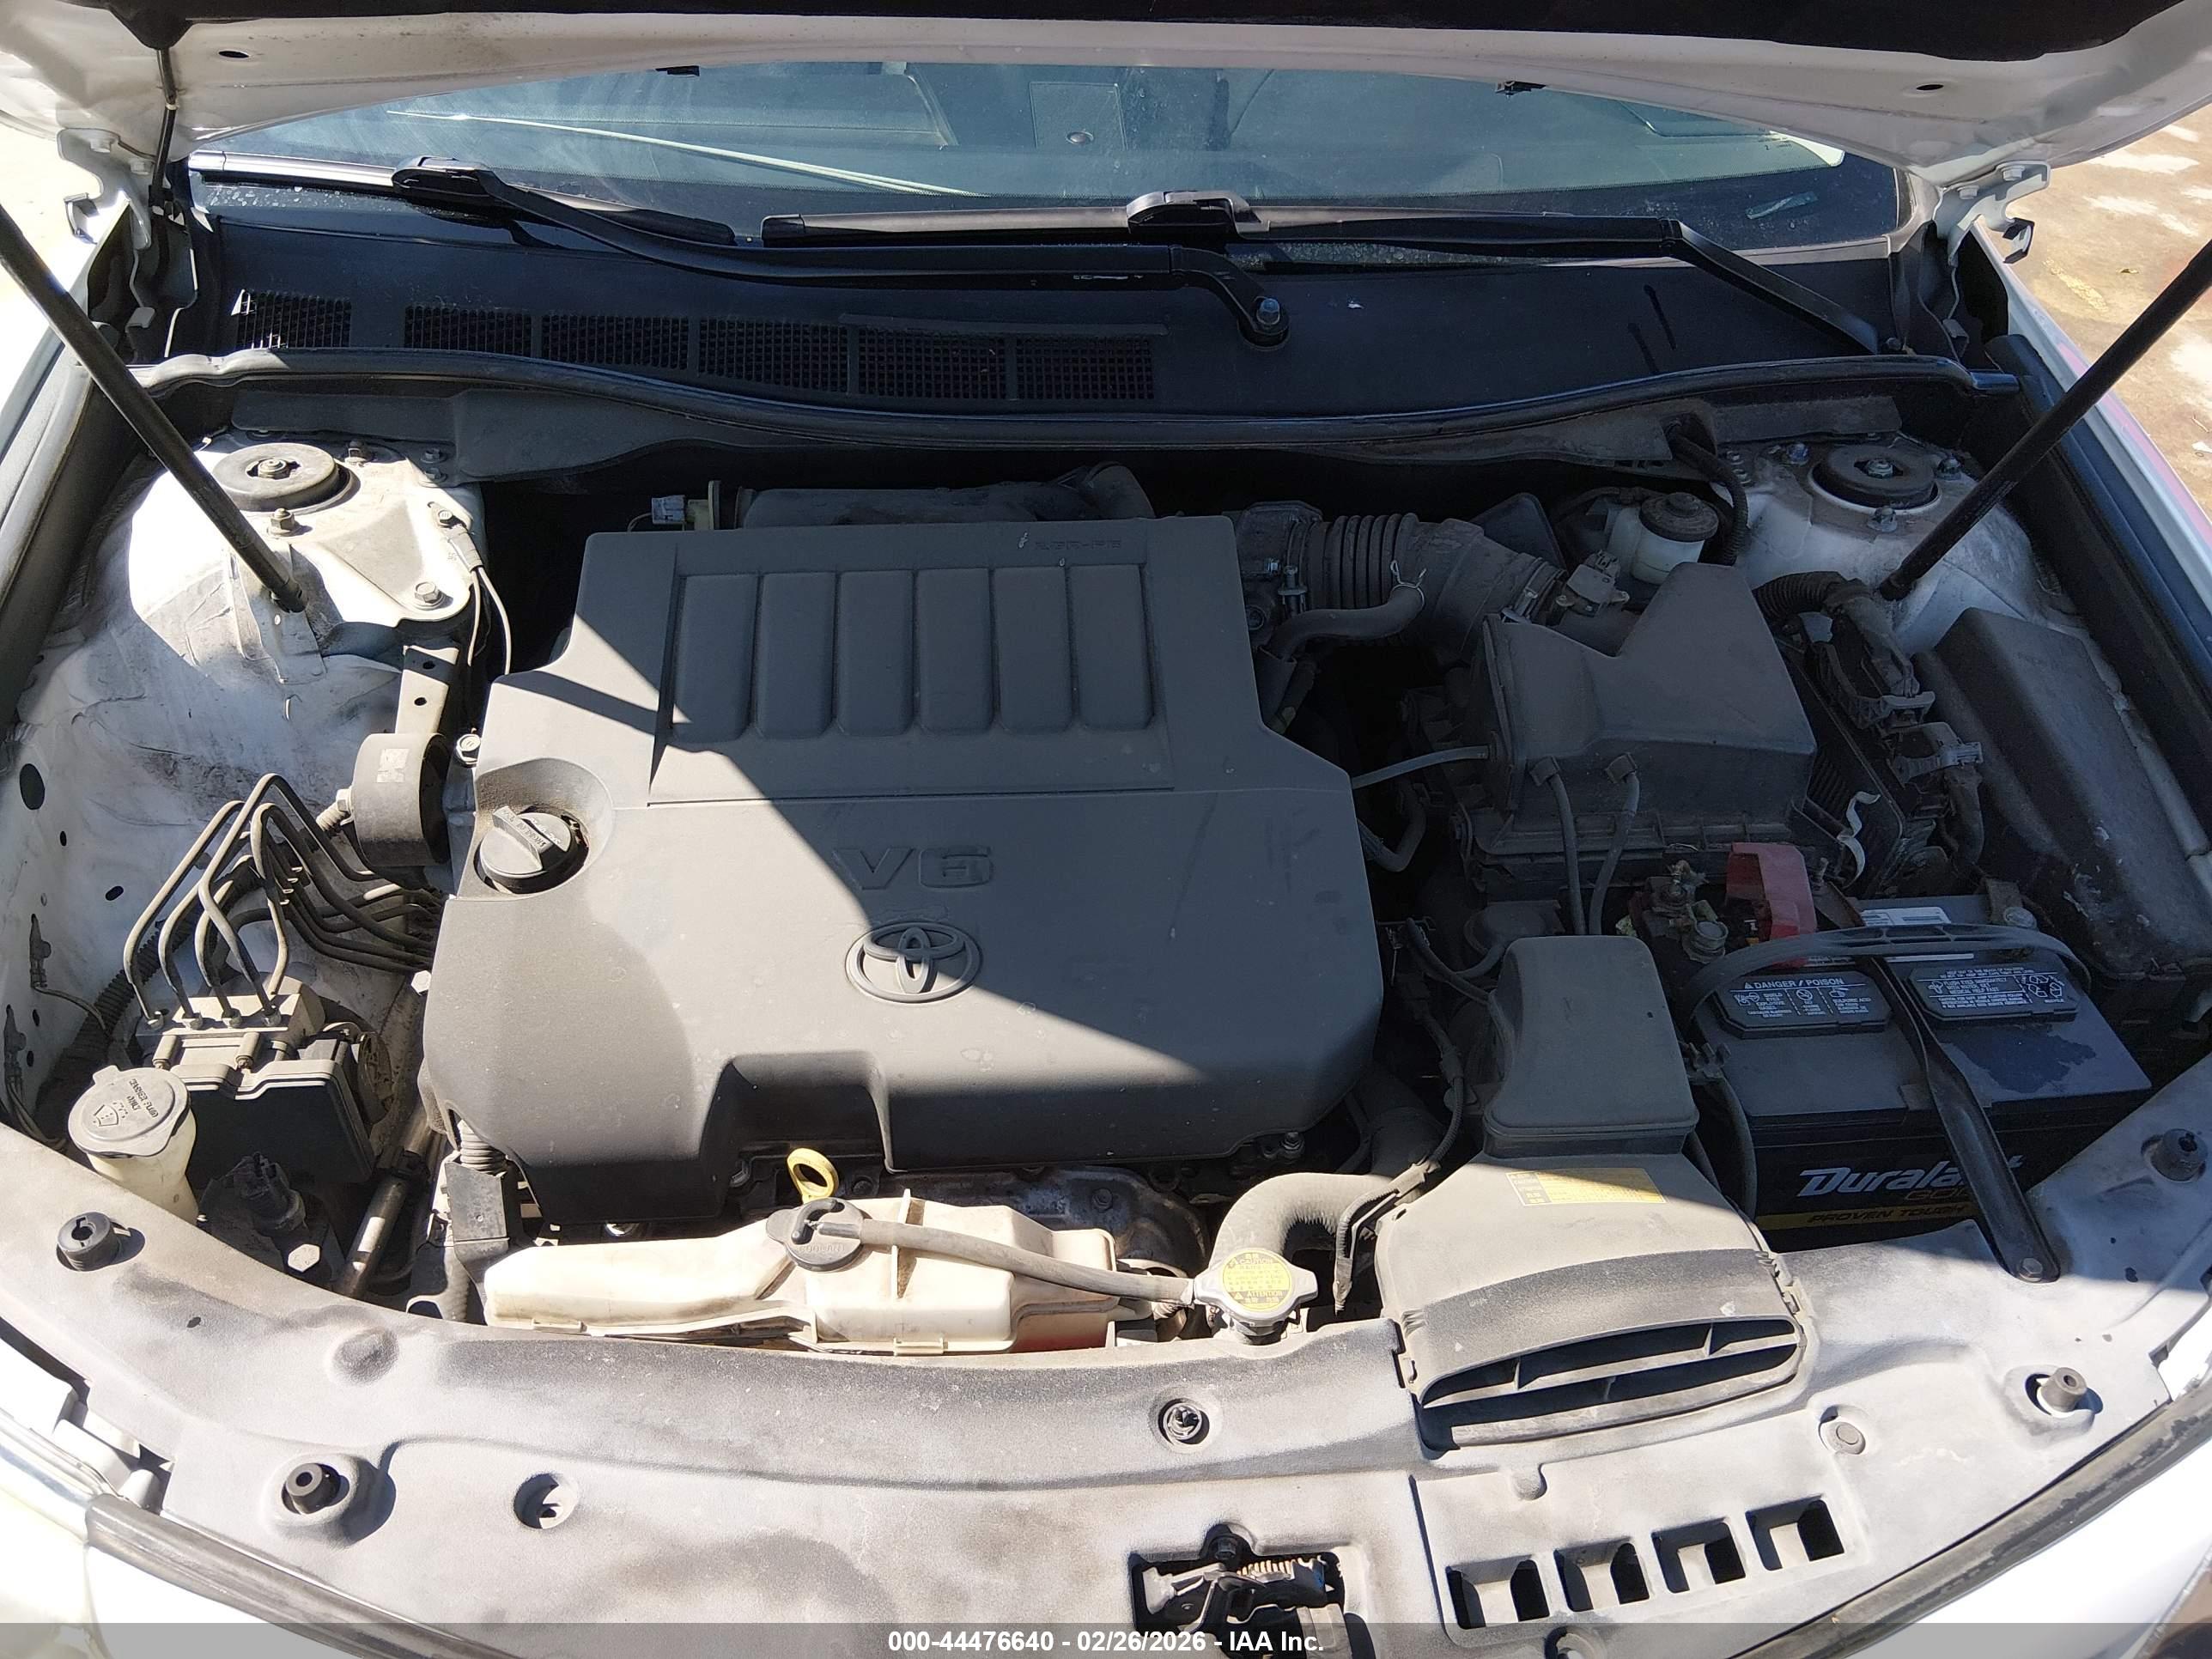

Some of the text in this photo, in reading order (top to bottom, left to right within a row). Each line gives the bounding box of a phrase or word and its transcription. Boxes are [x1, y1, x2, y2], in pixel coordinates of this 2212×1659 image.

[830, 845, 994, 890] V6
[1753, 980, 1797, 989] DANGER
[1806, 977, 1845, 987] POISON
[1796, 1154, 2024, 1198] Durala
[1808, 1209, 1893, 1224] PROVEN
